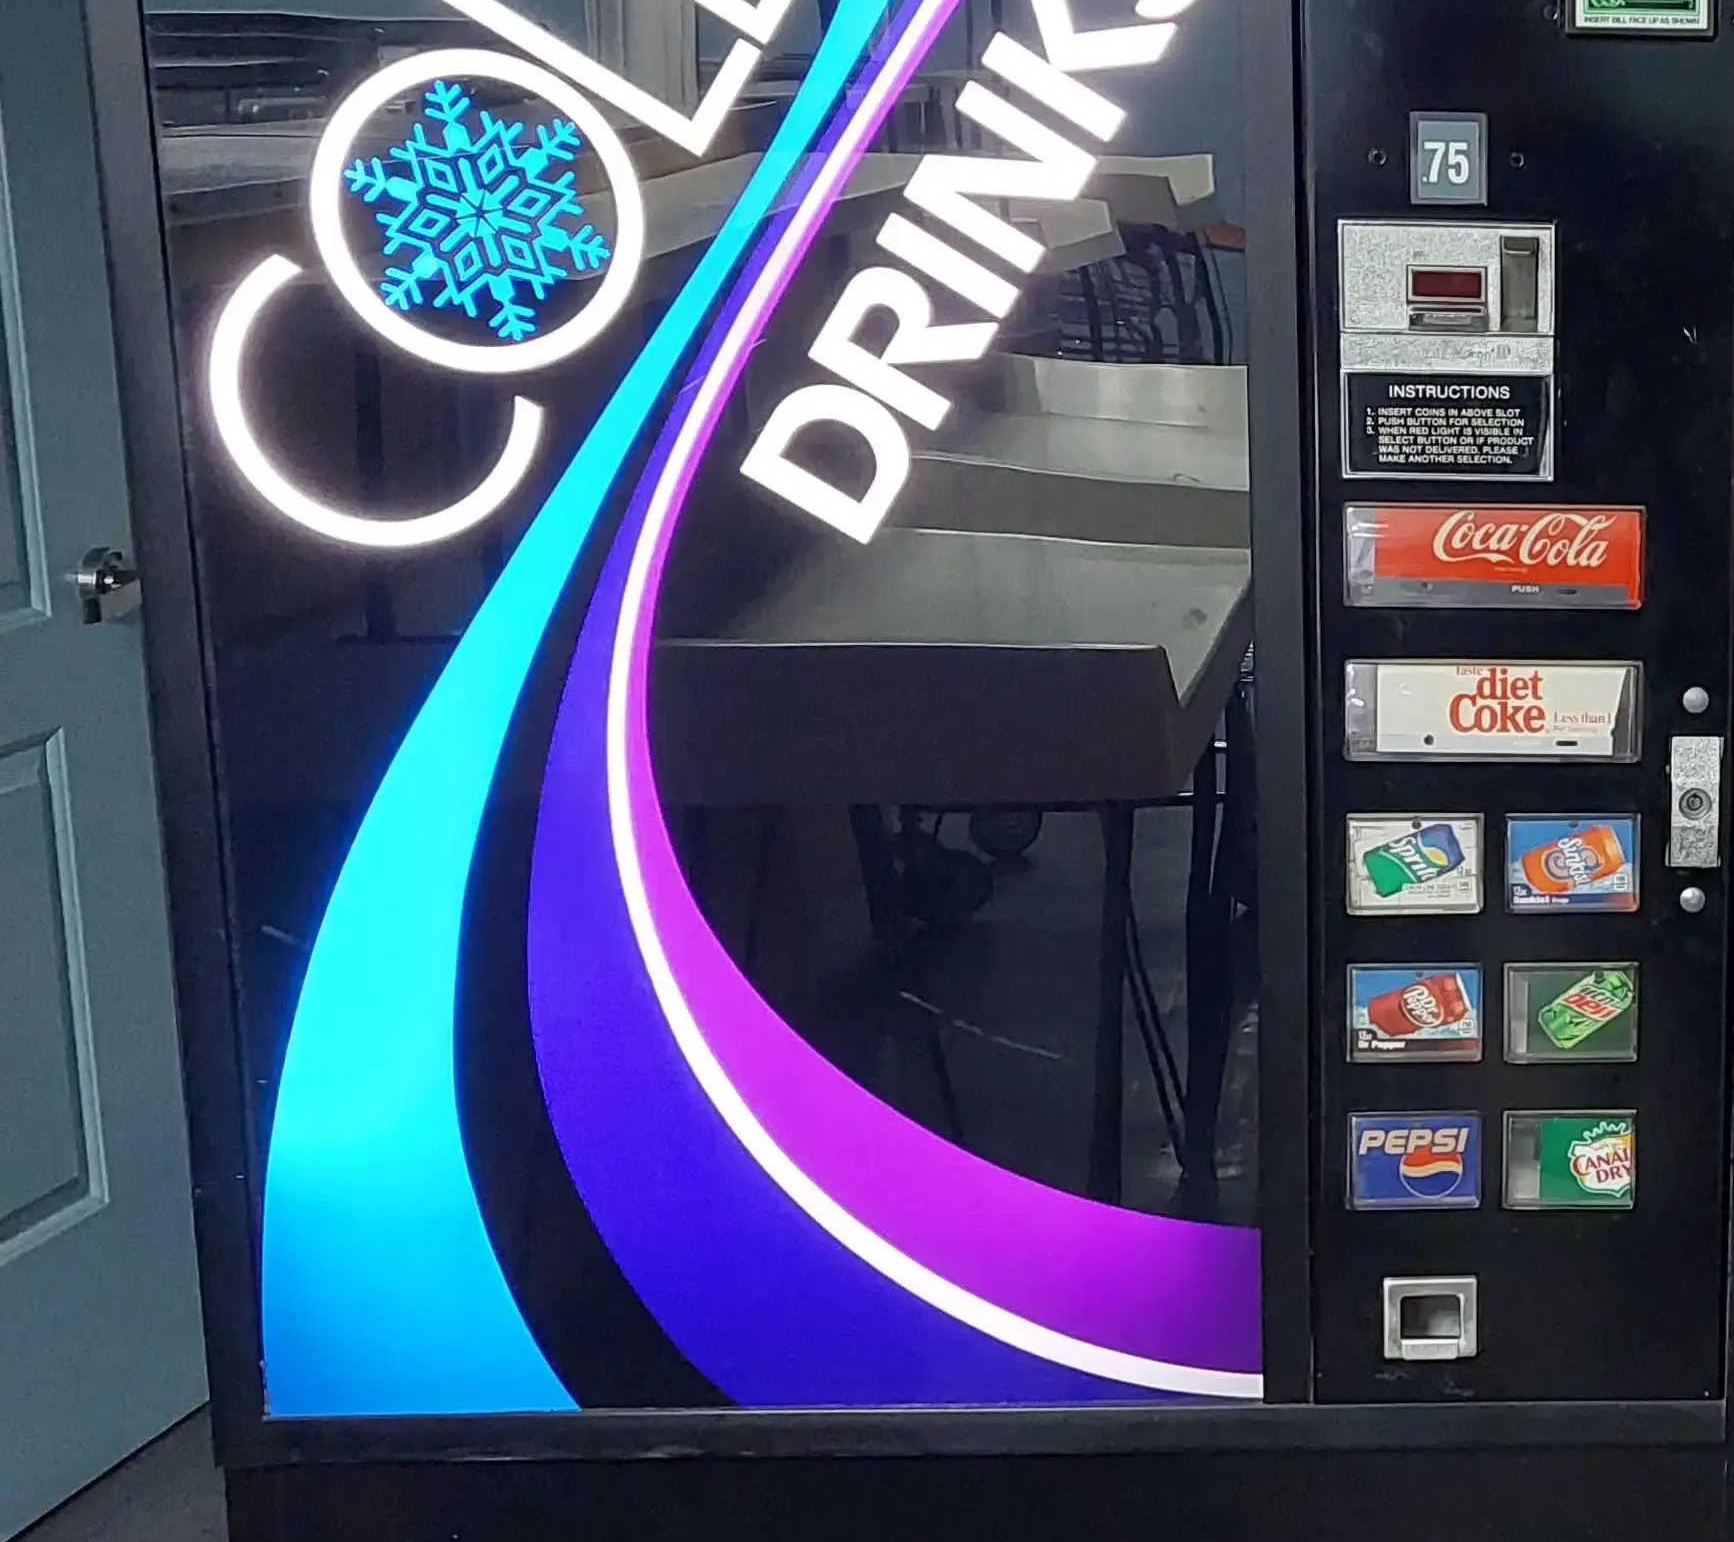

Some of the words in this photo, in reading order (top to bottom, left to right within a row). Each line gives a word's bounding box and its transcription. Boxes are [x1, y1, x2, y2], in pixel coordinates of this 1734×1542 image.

[1389, 385, 1511, 399] INSTRUCTIONS
[1378, 408, 1412, 416] INSERT
[1415, 408, 1445, 416] COINS
[1450, 418, 1468, 426] FOR
[1378, 427, 1407, 435] WHEN
[1409, 427, 1429, 435] RED
[1378, 436, 1414, 444] SELECT
[1417, 436, 1457, 444] BUTTON
[1460, 437, 1474, 445] OR
[1476, 437, 1485, 445] IF
[1488, 437, 1534, 445] PRODUCT
[1379, 455, 1405, 463] MAKE
[1408, 455, 1454, 463] ANOTHER
[1433, 510, 1617, 567] Coca-Cola
[1511, 585, 1541, 595] PUSH
[1476, 667, 1543, 700] diet
[1449, 693, 1545, 733] Coke
[1359, 1128, 1470, 1155] PEPSI
